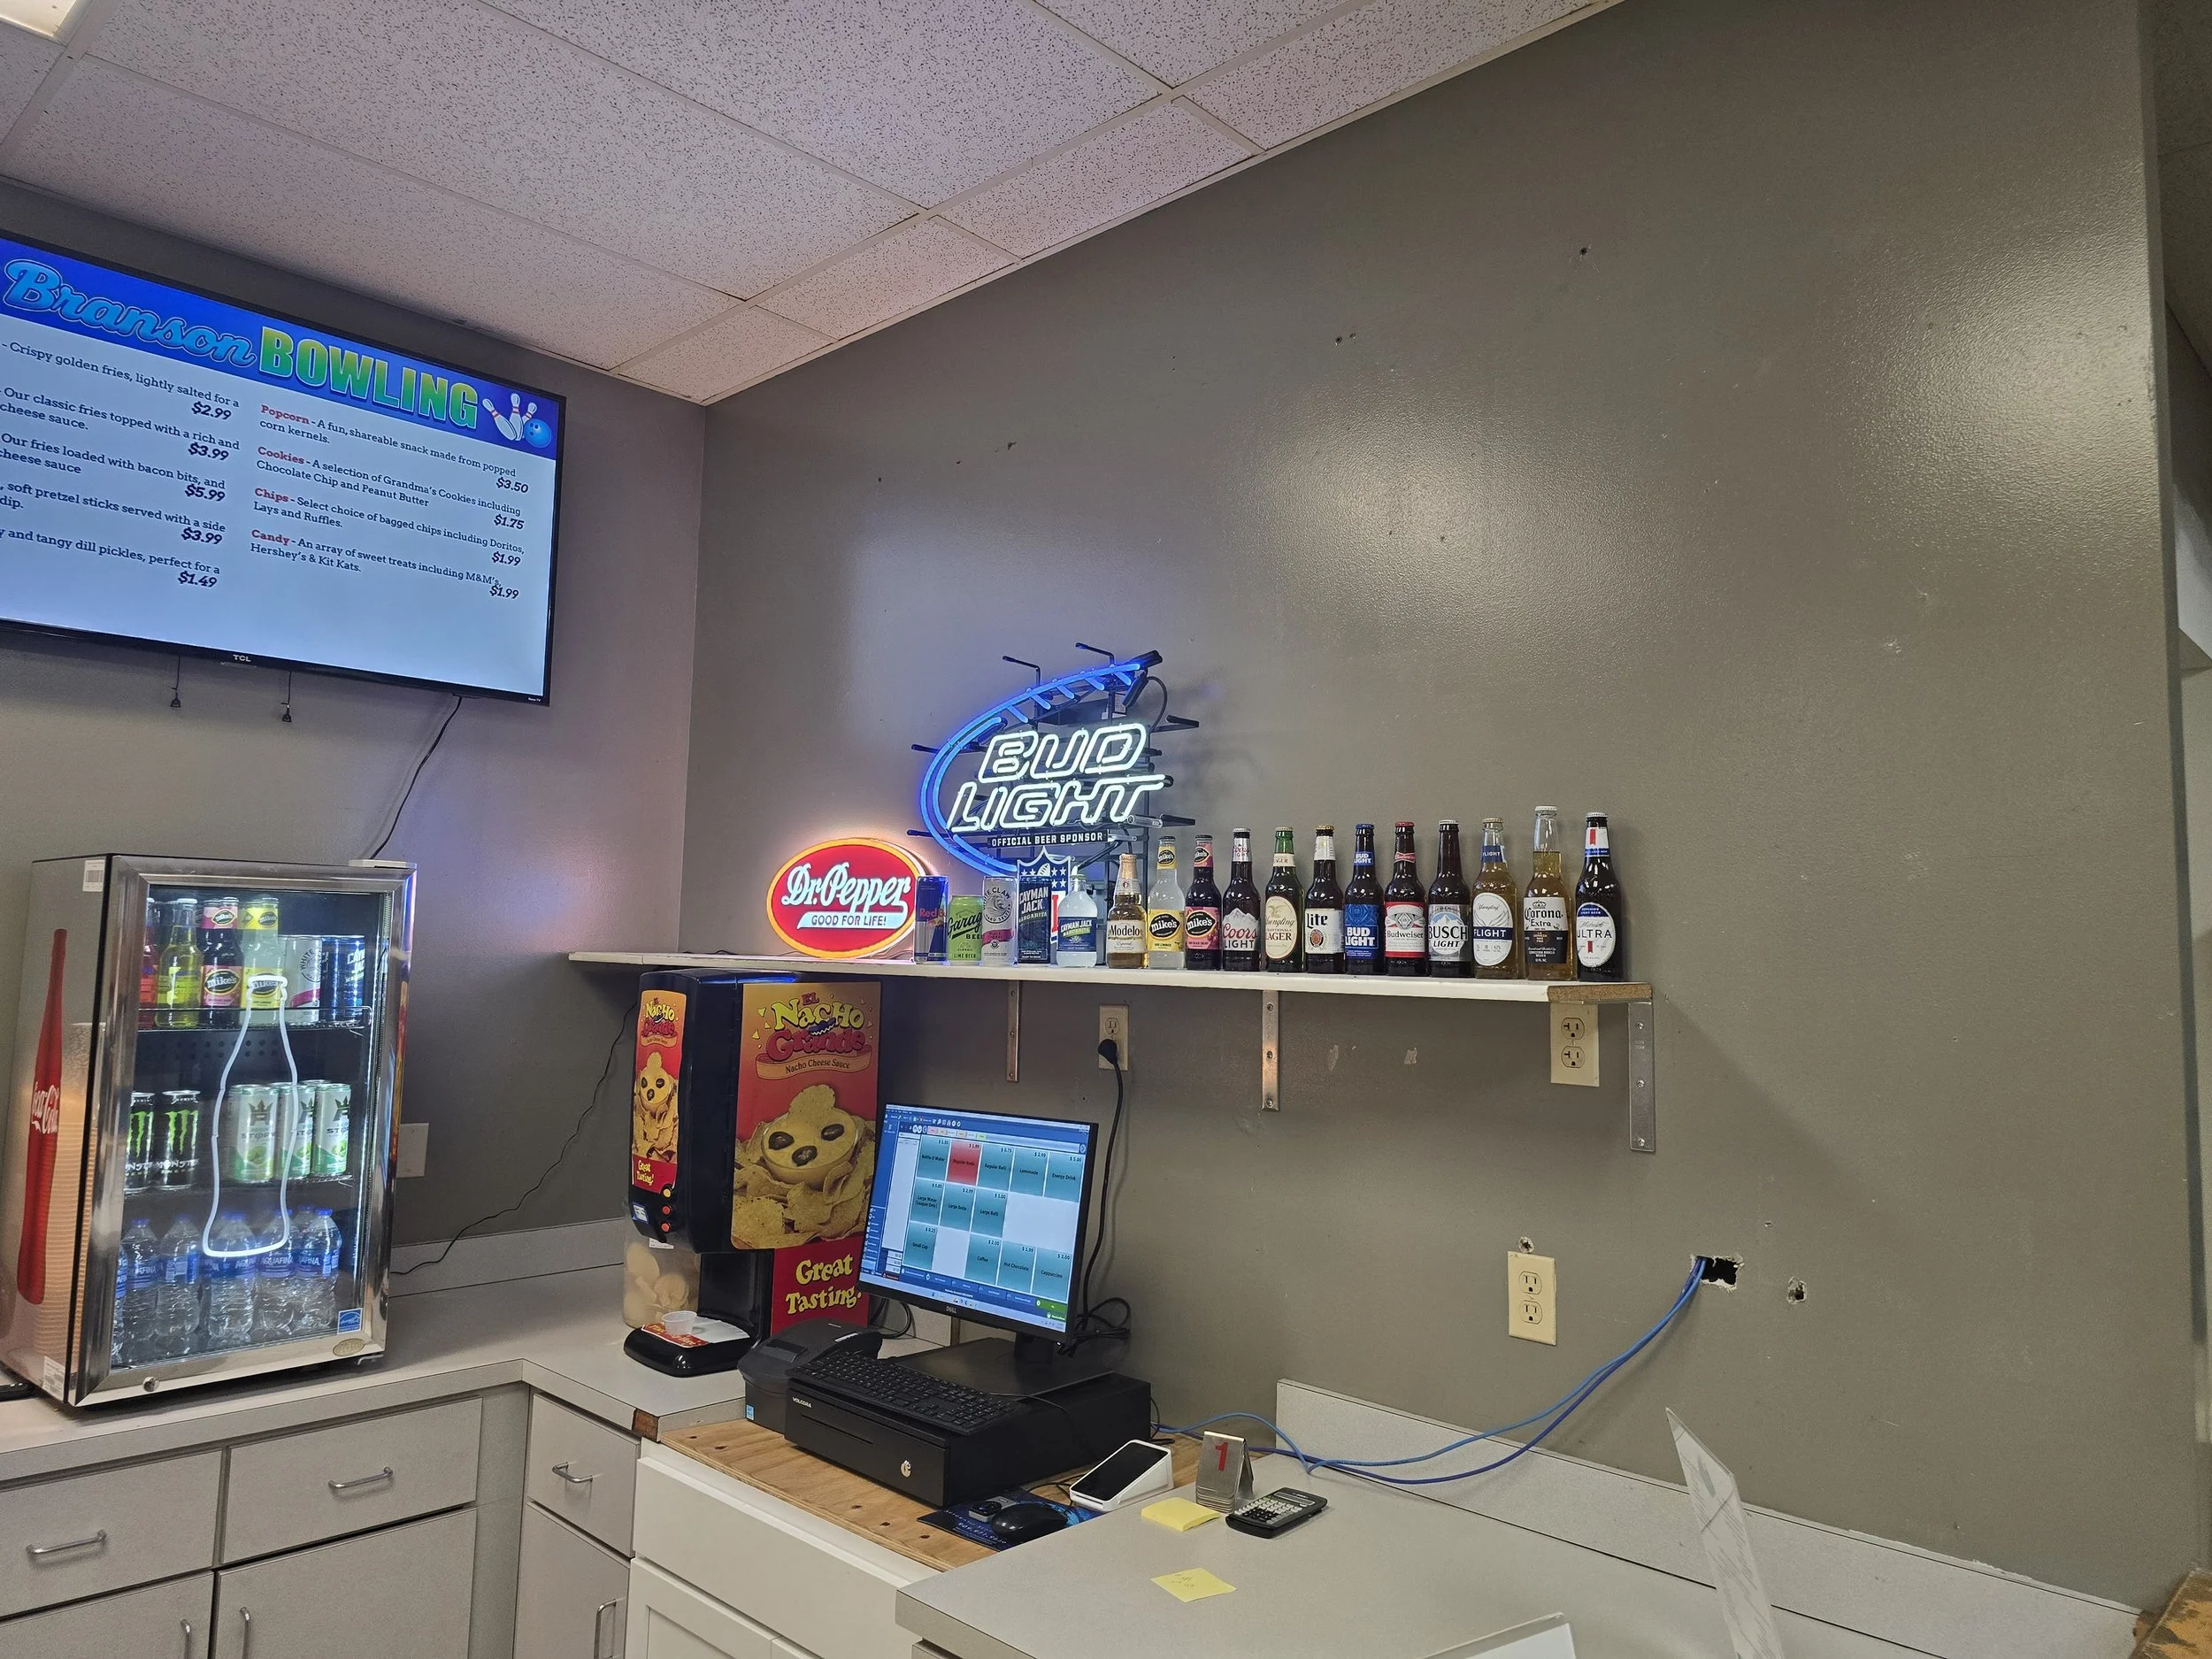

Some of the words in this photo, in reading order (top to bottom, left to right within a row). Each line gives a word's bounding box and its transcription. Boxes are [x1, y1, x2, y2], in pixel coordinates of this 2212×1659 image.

[4, 258, 257, 368] Branson
[258, 325, 479, 430] BOWLING
[10, 342, 53, 363] Crispy
[55, 356, 98, 372] golden
[102, 365, 132, 381] fries,
[135, 373, 174, 392] lightly
[176, 384, 211, 401] salted
[213, 393, 230, 405] for
[0, 403, 45, 419] cheese
[48, 415, 88, 430] sauce.
[4, 388, 29, 401] Our
[34, 395, 76, 411] classic
[78, 404, 108, 419] fries
[110, 412, 151, 430] topped
[154, 424, 180, 438] with
[192, 432, 216, 445] rich
[218, 439, 240, 451] and
[192, 401, 232, 420] $2.99
[259, 419, 285, 432] corn
[287, 425, 329, 443] kernels.
[260, 404, 309, 425] Popcorn
[327, 421, 348, 435] fun,
[349, 428, 397, 449] shareable
[400, 442, 428, 455] snack
[430, 449, 456, 461] made
[457, 455, 481, 469] from
[482, 462, 516, 478] popped
[188, 442, 228, 461] $3.99
[2, 433, 28, 447] Our
[30, 439, 59, 453] fries
[62, 445, 105, 465] loaded
[107, 457, 134, 470] with
[137, 462, 173, 478] bacon
[177, 470, 201, 486] bits,
[204, 478, 225, 490] and
[44, 460, 81, 473] sauce
[257, 446, 303, 464] Cookies
[322, 463, 368, 480] selection
[383, 476, 436, 495] Grandma's
[438, 488, 476, 505] Cookies
[477, 498, 521, 516] including
[257, 459, 311, 480] Chocolate
[313, 473, 338, 488] Chip
[340, 481, 359, 494] and
[362, 483, 397, 500] Peanut
[398, 492, 429, 508] Butter
[495, 477, 529, 494] $3.50
[185, 483, 226, 502] $5.99
[7, 483, 33, 495] soft
[35, 488, 80, 504] pretzel
[81, 497, 119, 511] sticks
[121, 505, 161, 519] served
[164, 512, 191, 526] with
[202, 519, 226, 534] side
[253, 501, 279, 515] Lays
[280, 508, 301, 520] and
[303, 511, 342, 528] Ruffles.
[255, 488, 288, 503] Chips
[296, 496, 330, 511] Select
[331, 504, 365, 518] choice
[379, 513, 415, 531] bagged
[416, 522, 442, 536] chips
[443, 526, 488, 547] including
[489, 538, 525, 555] Doritos,
[493, 514, 525, 530] $1.75
[181, 526, 222, 545] $3.99
[8, 529, 34, 541] and
[35, 534, 73, 549] tangy
[75, 540, 96, 552] dill
[98, 545, 147, 562] pickles,
[149, 554, 192, 572] perfect
[194, 561, 211, 573] for
[250, 542, 306, 562] Hershey's
[318, 555, 334, 566] Kit
[336, 559, 361, 572] Kats.
[251, 529, 289, 548] Candy
[297, 538, 313, 549] An
[315, 541, 342, 557] array
[357, 552, 387, 565] sweet
[388, 557, 417, 571] treats
[419, 561, 464, 581] including
[491, 550, 521, 566] $1.99
[177, 571, 218, 588] $1.49
[489, 585, 519, 600] $1.99
[978, 723, 1147, 784] BUD
[946, 774, 1166, 833] LIGHT
[991, 836, 1032, 847] OFFICIAL
[1034, 835, 1056, 845] BEER
[1060, 832, 1102, 844] SPONSOR
[781, 863, 822, 907] Dr.
[820, 862, 911, 914] Pepper
[991, 887, 1010, 900] CLAW
[1019, 887, 1048, 904] CAYMAN
[919, 908, 937, 918] Red
[1021, 899, 1044, 914] JACK
[1525, 907, 1562, 921] Corona
[811, 915, 839, 926] GOOD
[841, 915, 860, 926] FOR
[864, 914, 887, 926] LIFE!
[947, 911, 983, 940] Garag
[1150, 918, 1178, 933] mike's
[1187, 917, 1213, 931] mike's
[1307, 913, 1328, 928] Lite
[1110, 925, 1141, 936] Modelo
[1223, 922, 1257, 940] Coors
[1347, 926, 1371, 936] BUD
[1386, 930, 1424, 939] Budweiser
[1428, 926, 1468, 941] BUSCH
[1224, 940, 1255, 949] LIGHT
[1345, 937, 1375, 947] LIGHT
[207, 977, 237, 988] mike's
[802, 992, 819, 1005] EL
[766, 1028, 865, 1062] Grande
[786, 1062, 807, 1073] Nacho
[832, 1059, 850, 1069] Sauce
[796, 1253, 853, 1285] Great
[1215, 1441, 1229, 1471] 1
